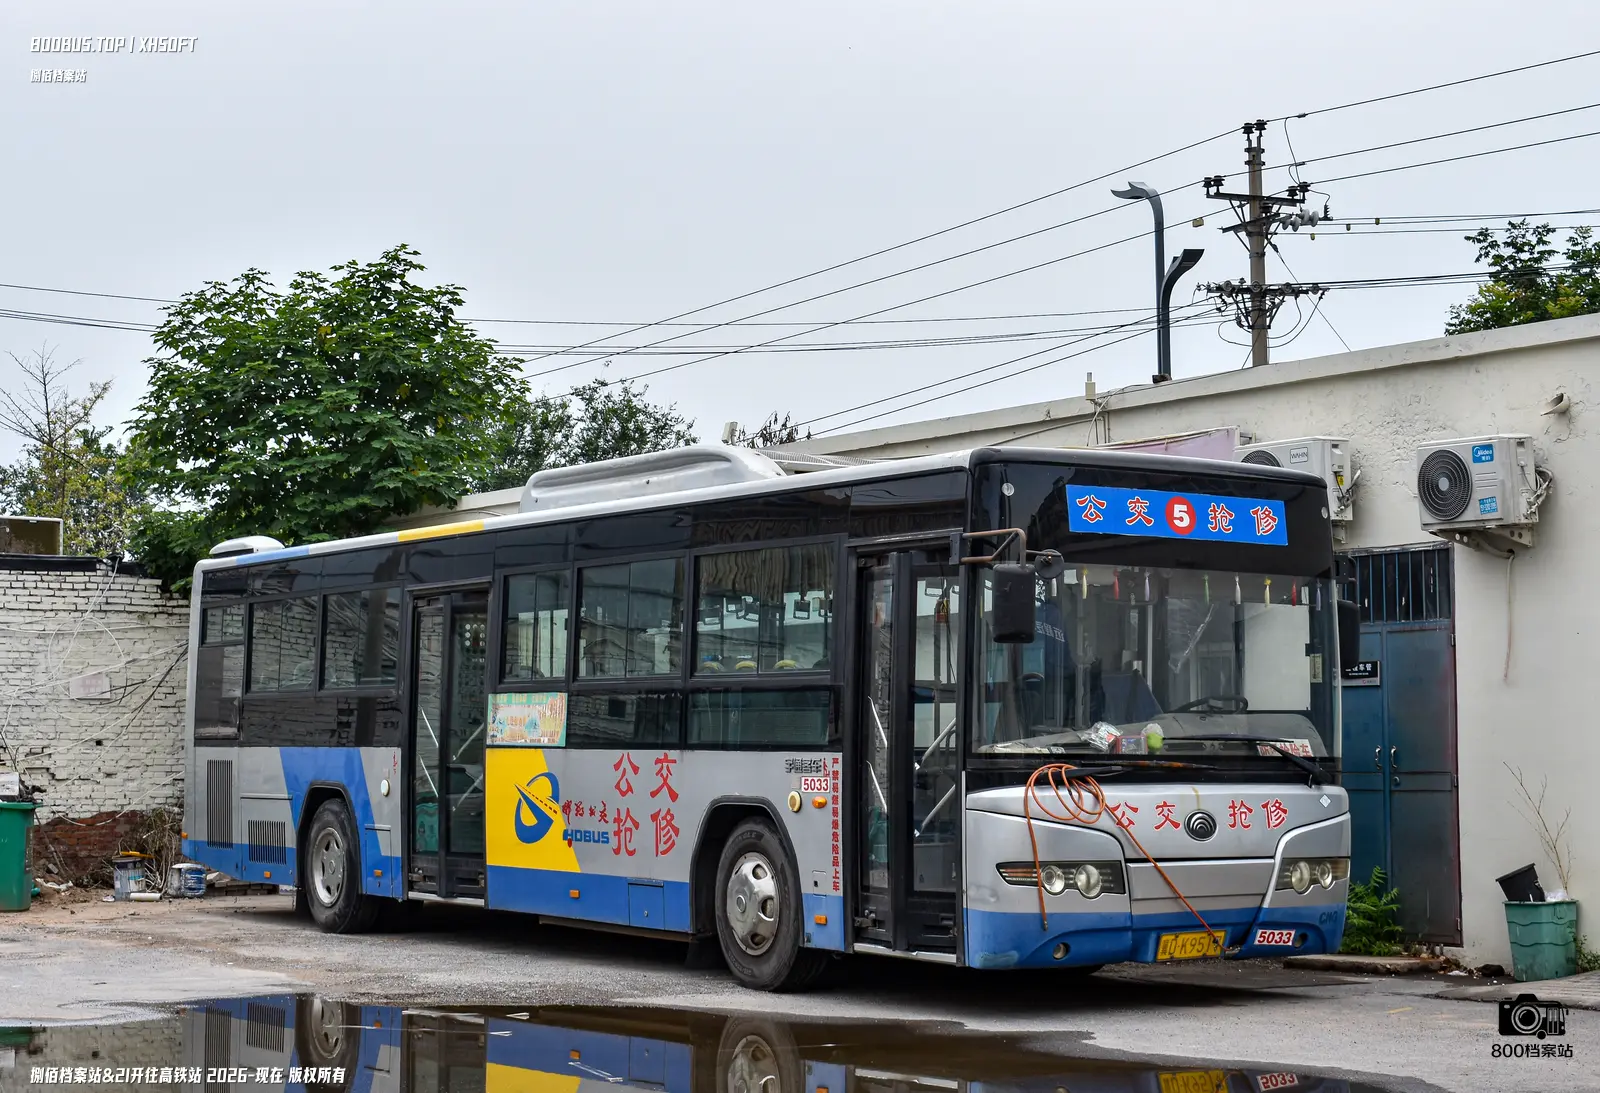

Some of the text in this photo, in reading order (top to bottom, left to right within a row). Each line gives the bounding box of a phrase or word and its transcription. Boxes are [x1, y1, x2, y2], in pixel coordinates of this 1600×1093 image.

[1474, 447, 1493, 458] Midea
[1076, 494, 1278, 535] 公交 5 抢修
[803, 778, 829, 792] 5033
[1227, 798, 1289, 830] 抢修
[562, 828, 610, 844] HDBUS
[1257, 931, 1292, 944] 5033
